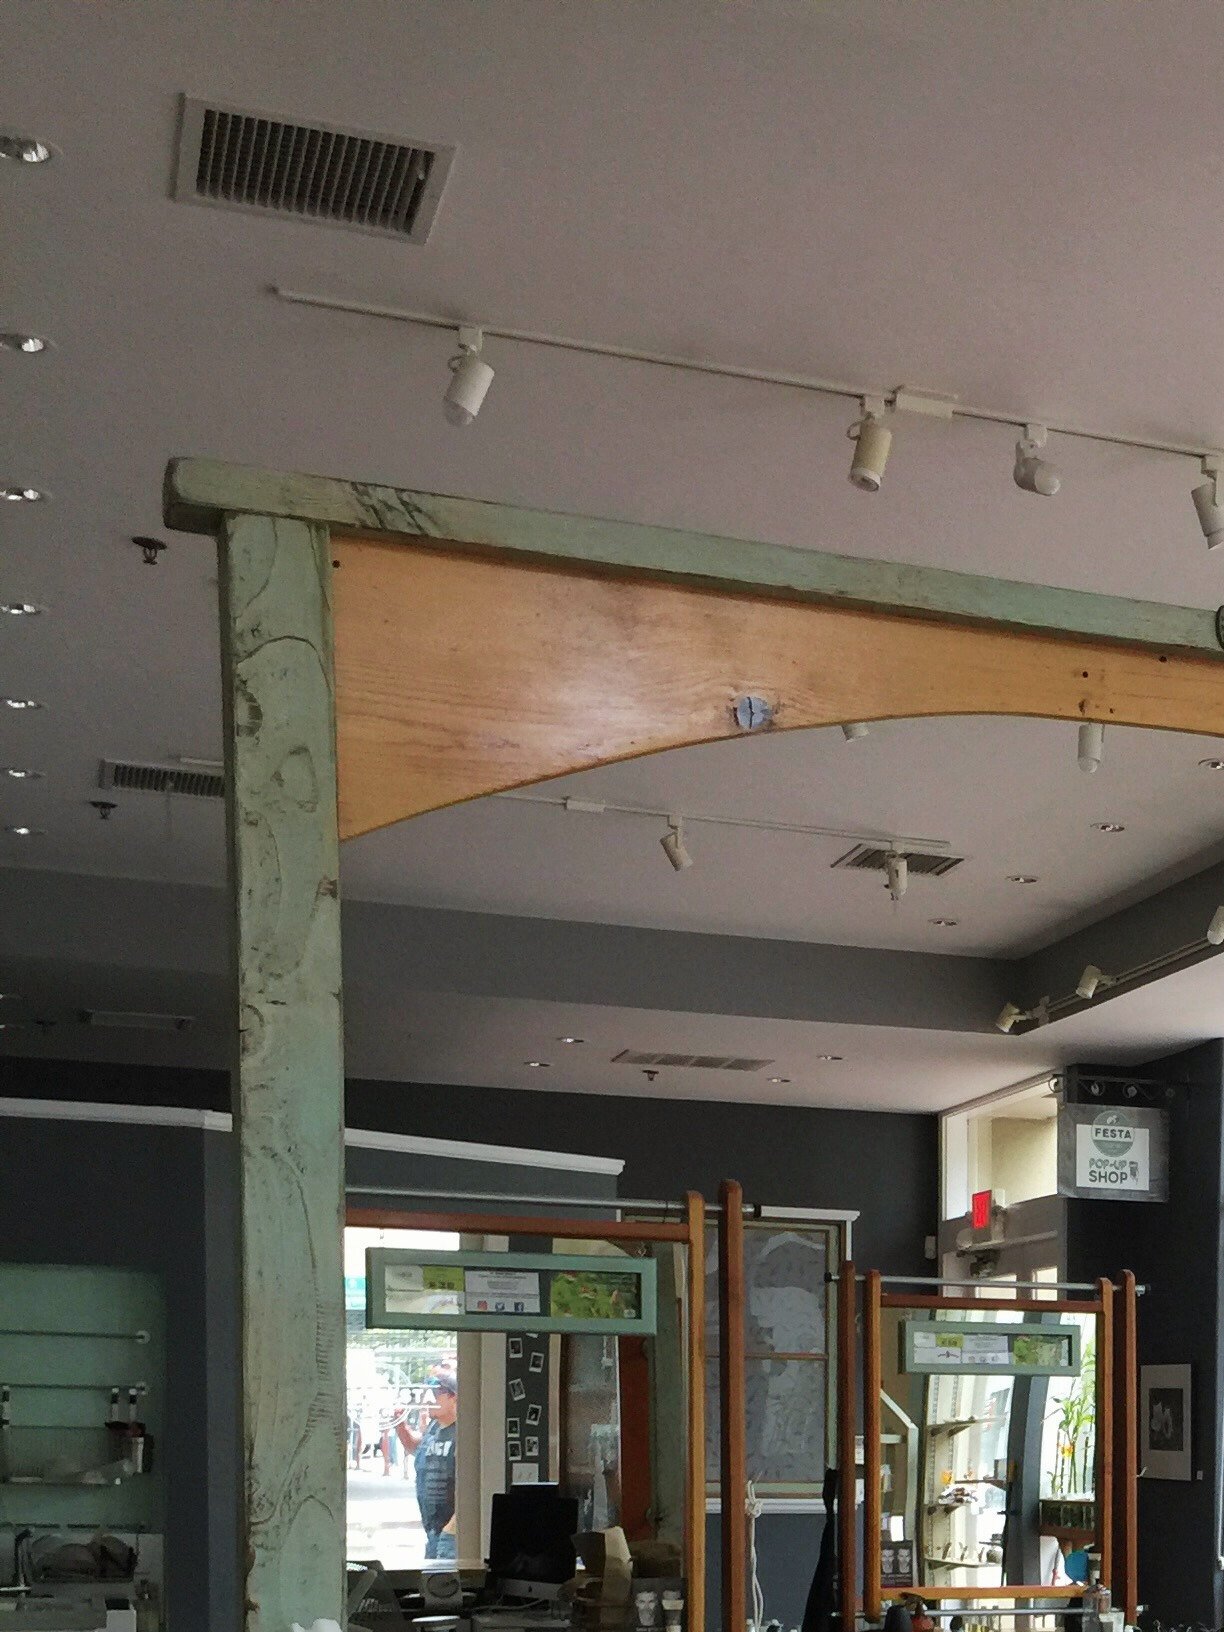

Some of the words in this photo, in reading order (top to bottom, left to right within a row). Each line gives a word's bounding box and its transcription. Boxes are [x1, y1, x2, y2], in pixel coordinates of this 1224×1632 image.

[1095, 1127, 1132, 1139] FESTA
[1089, 1157, 1127, 1170] POP-UP
[1089, 1170, 1128, 1183] SHOP
